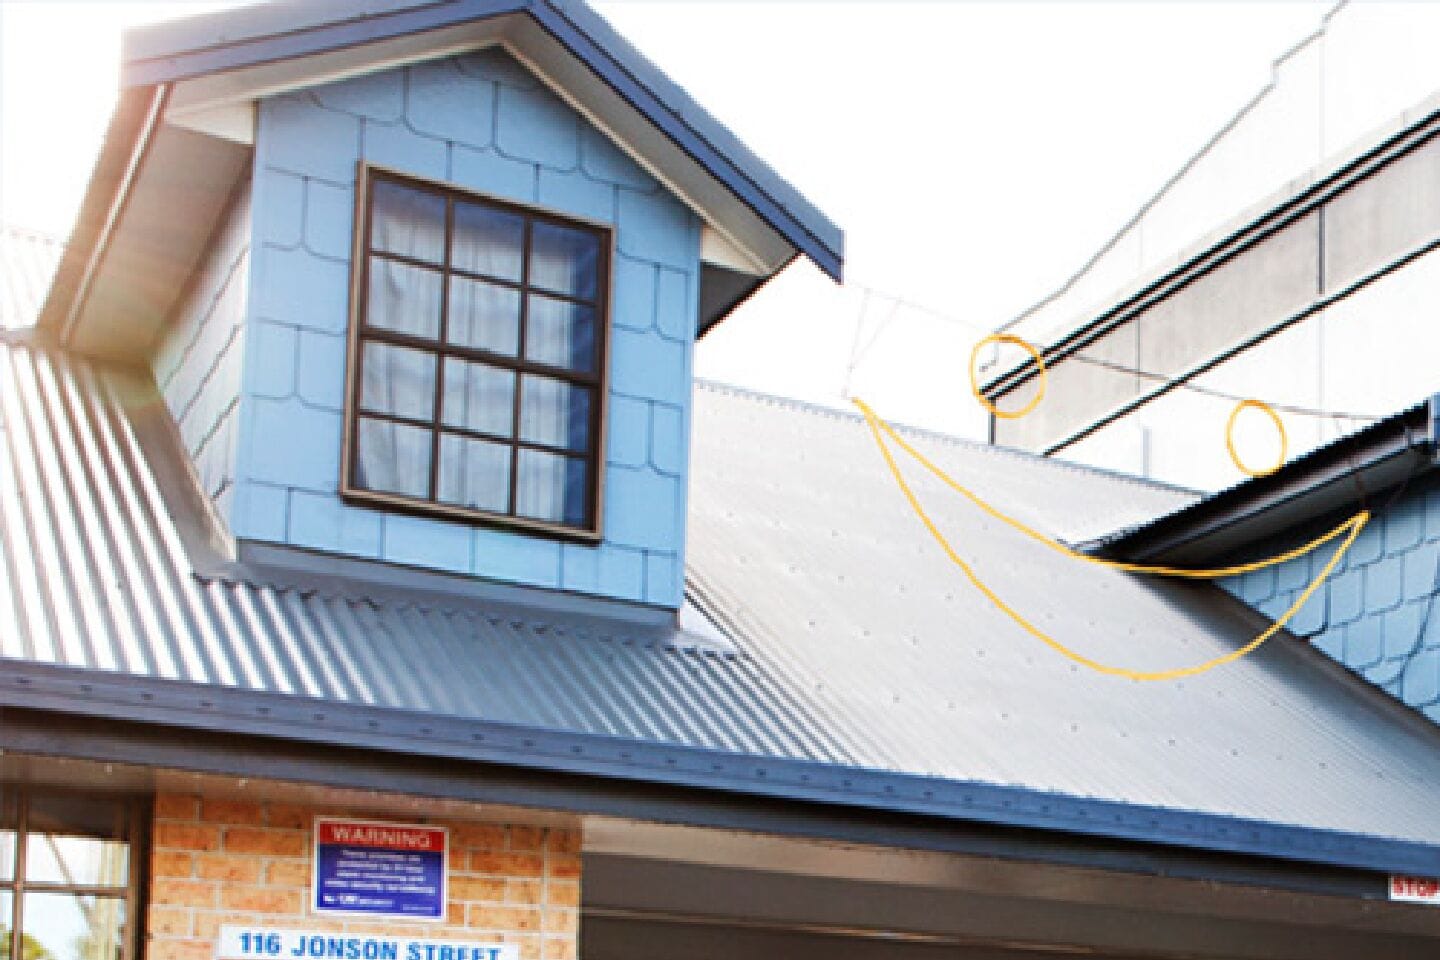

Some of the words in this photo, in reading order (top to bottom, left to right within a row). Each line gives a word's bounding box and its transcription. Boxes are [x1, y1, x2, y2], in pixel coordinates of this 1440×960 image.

[332, 824, 431, 848] WARNING
[1393, 875, 1440, 897] STOP
[239, 931, 282, 955] 116
